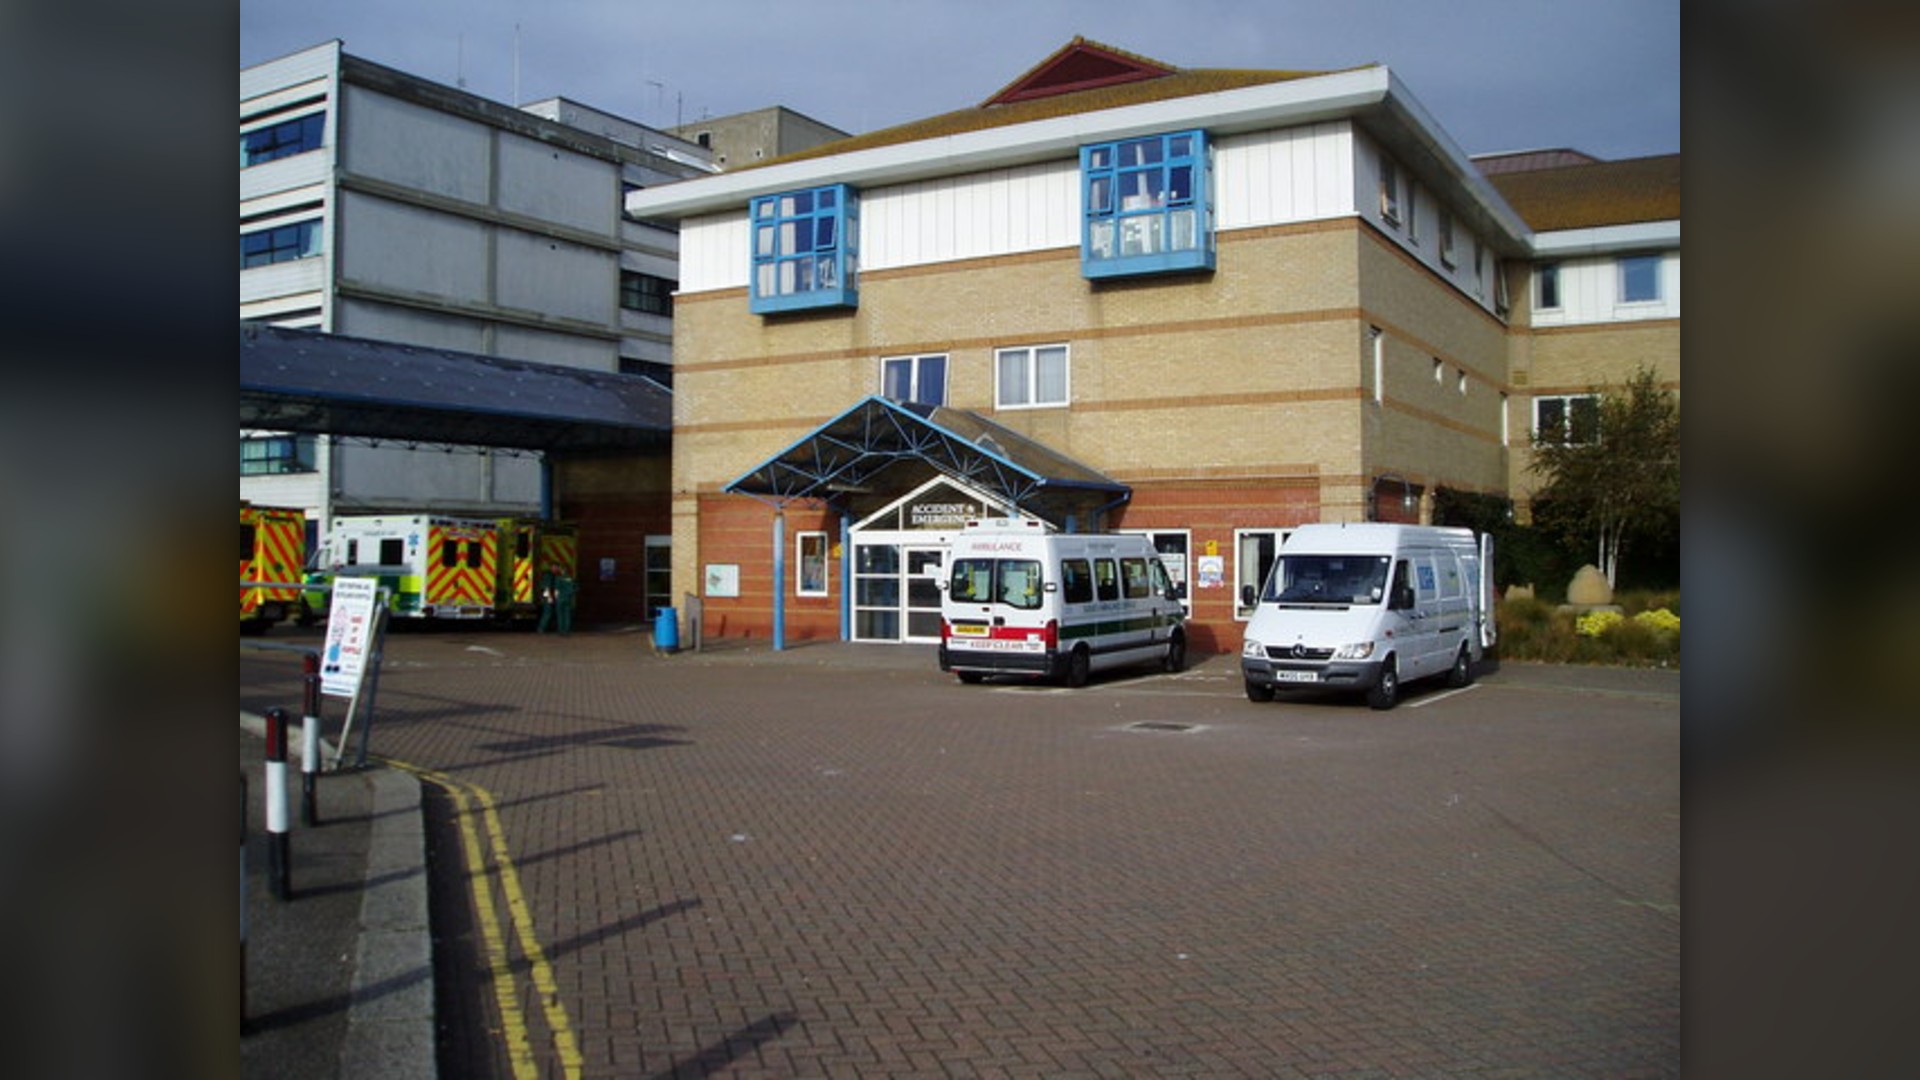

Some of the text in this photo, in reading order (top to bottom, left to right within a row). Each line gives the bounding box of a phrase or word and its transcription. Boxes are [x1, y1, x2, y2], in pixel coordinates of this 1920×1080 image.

[911, 504, 964, 514] ACCIDENT
[971, 542, 1022, 552] AMBULANCE
[970, 641, 991, 649] KEEP
[992, 641, 1024, 650] CLEAN
